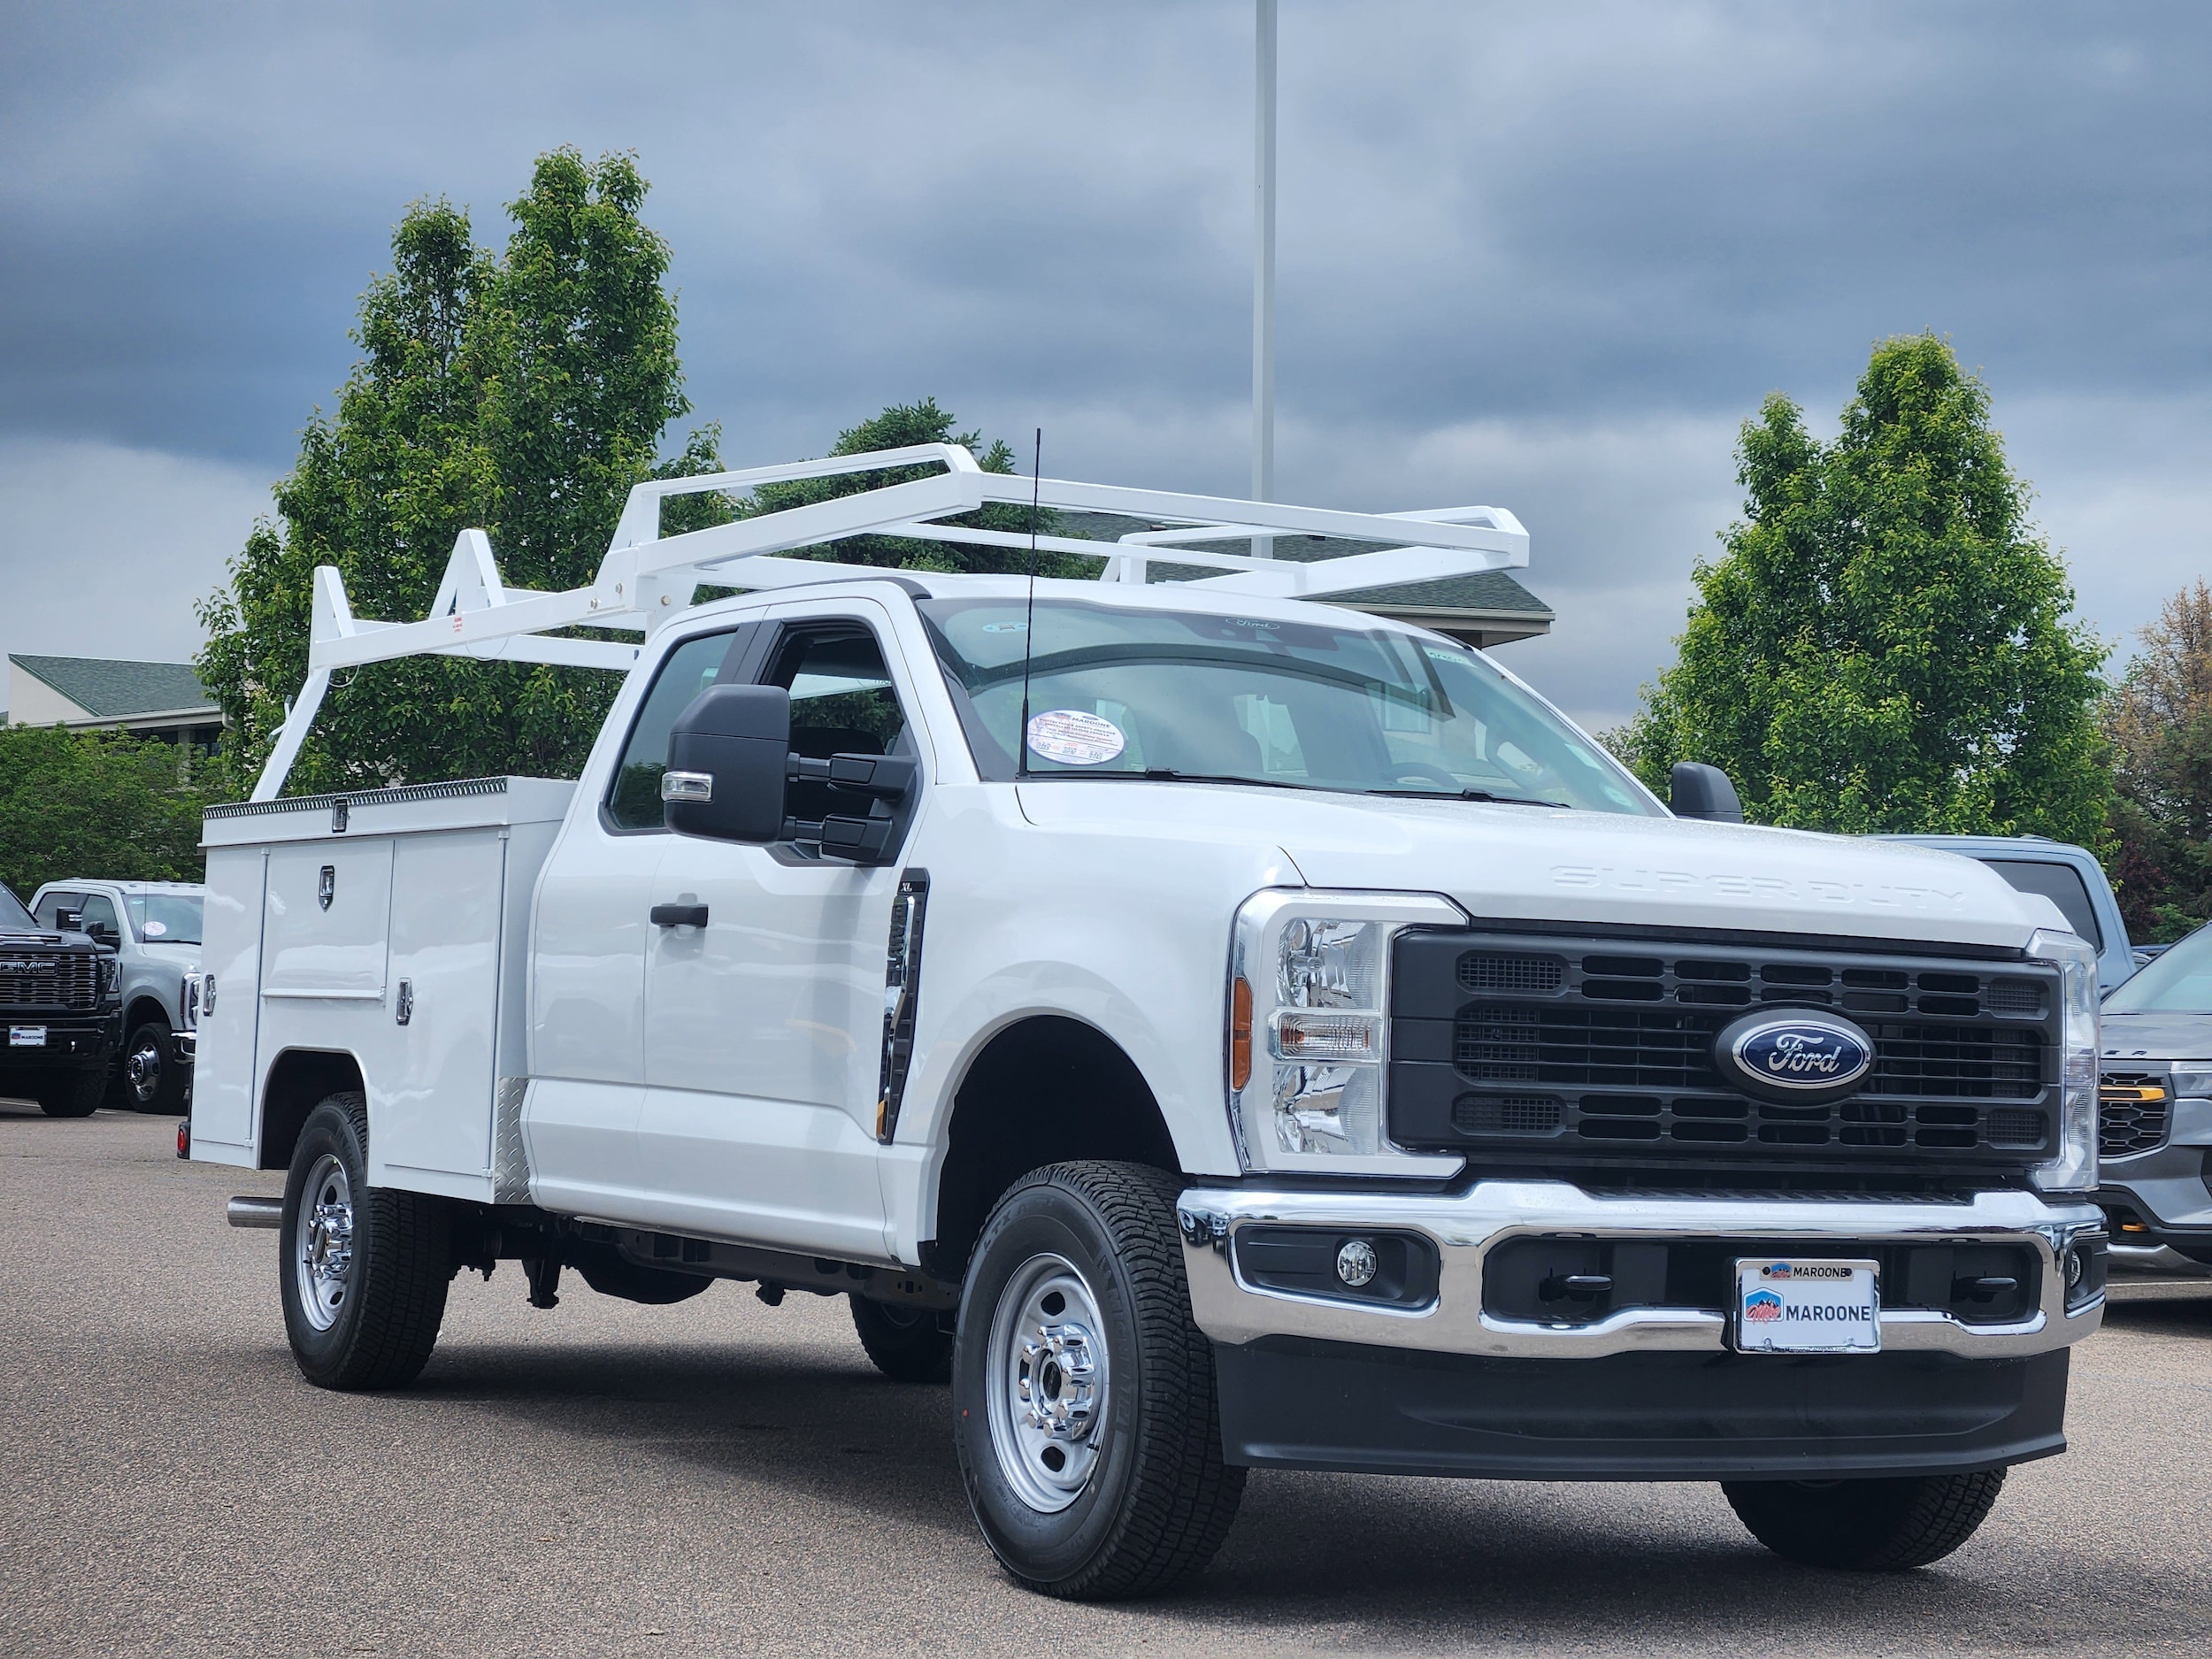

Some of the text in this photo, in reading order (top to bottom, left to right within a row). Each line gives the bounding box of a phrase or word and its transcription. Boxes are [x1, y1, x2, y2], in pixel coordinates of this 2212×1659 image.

[1071, 718, 1110, 727] MAROONE
[901, 882, 913, 893] XL
[1550, 865, 1965, 912] SUPER DUTY
[0, 961, 56, 973] GMC
[1769, 1033, 1842, 1073] Ford
[1793, 1267, 1847, 1278] MAROONE
[1786, 1305, 1871, 1322] MAROONE
